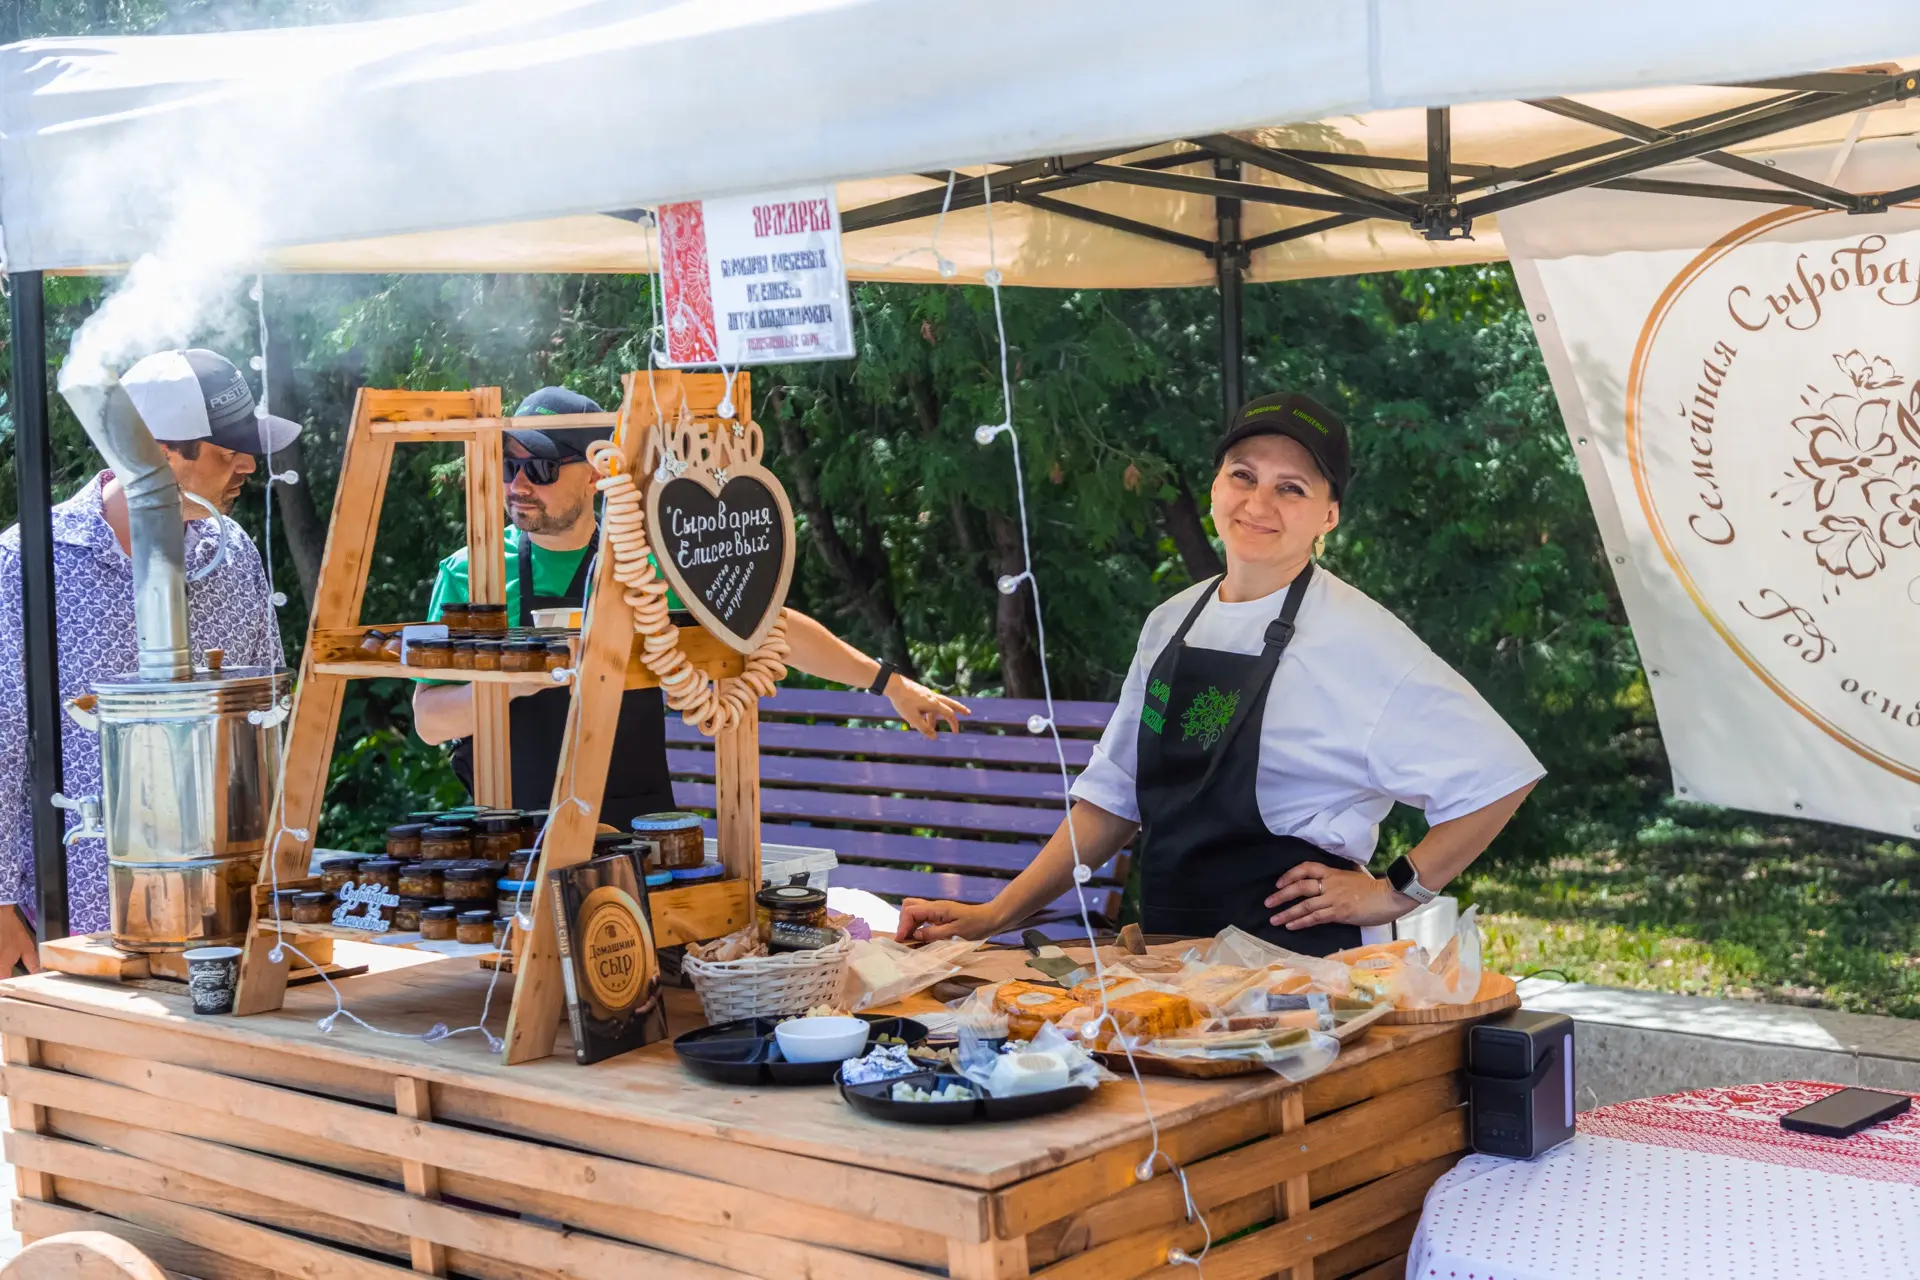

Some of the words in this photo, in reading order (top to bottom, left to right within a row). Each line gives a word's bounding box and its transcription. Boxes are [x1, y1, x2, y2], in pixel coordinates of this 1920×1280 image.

[752, 198, 832, 239] ЯРМАРКА
[1677, 340, 1738, 546] Семейная
[589, 935, 636, 962] Домашний
